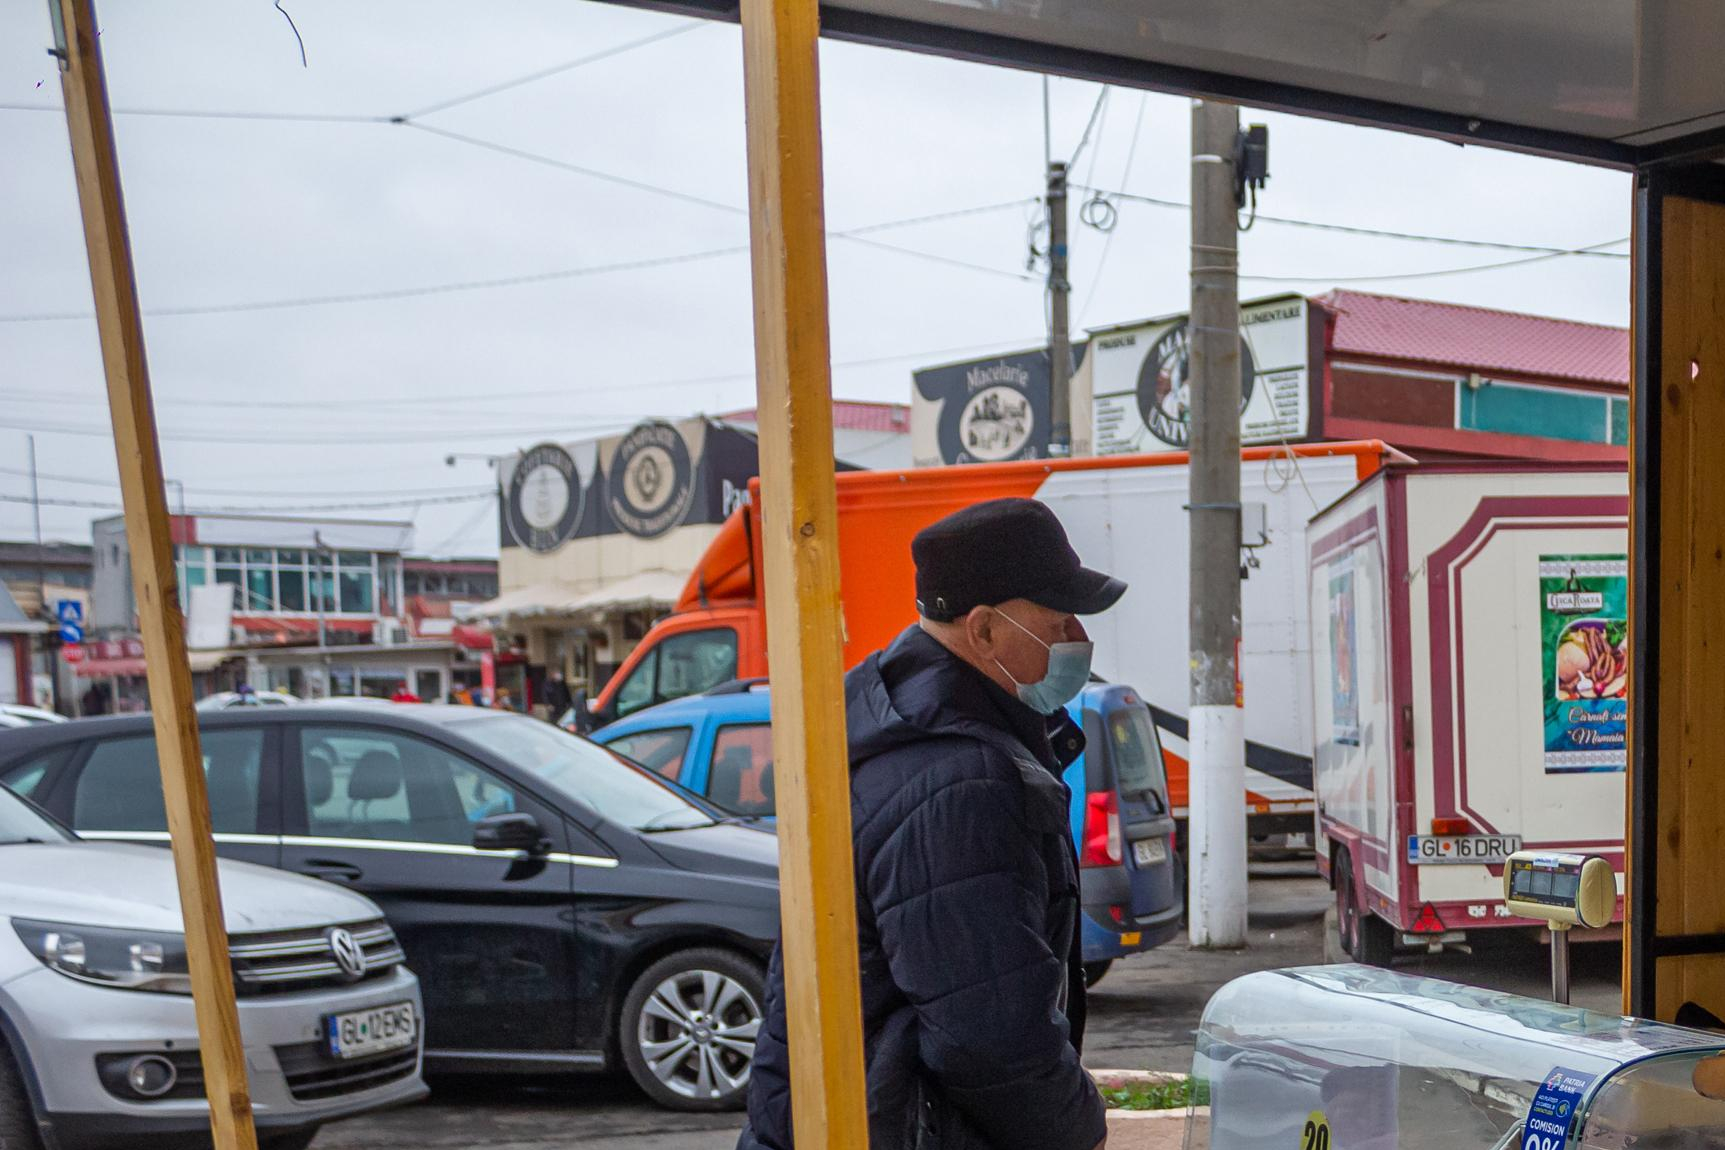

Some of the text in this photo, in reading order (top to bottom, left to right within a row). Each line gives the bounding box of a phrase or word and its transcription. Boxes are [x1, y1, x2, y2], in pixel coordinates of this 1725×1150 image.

[1422, 838, 1516, 858] GL 16 DRU
[1558, 1084, 1577, 1095] BANK
[1530, 1118, 1565, 1137] COMISION
